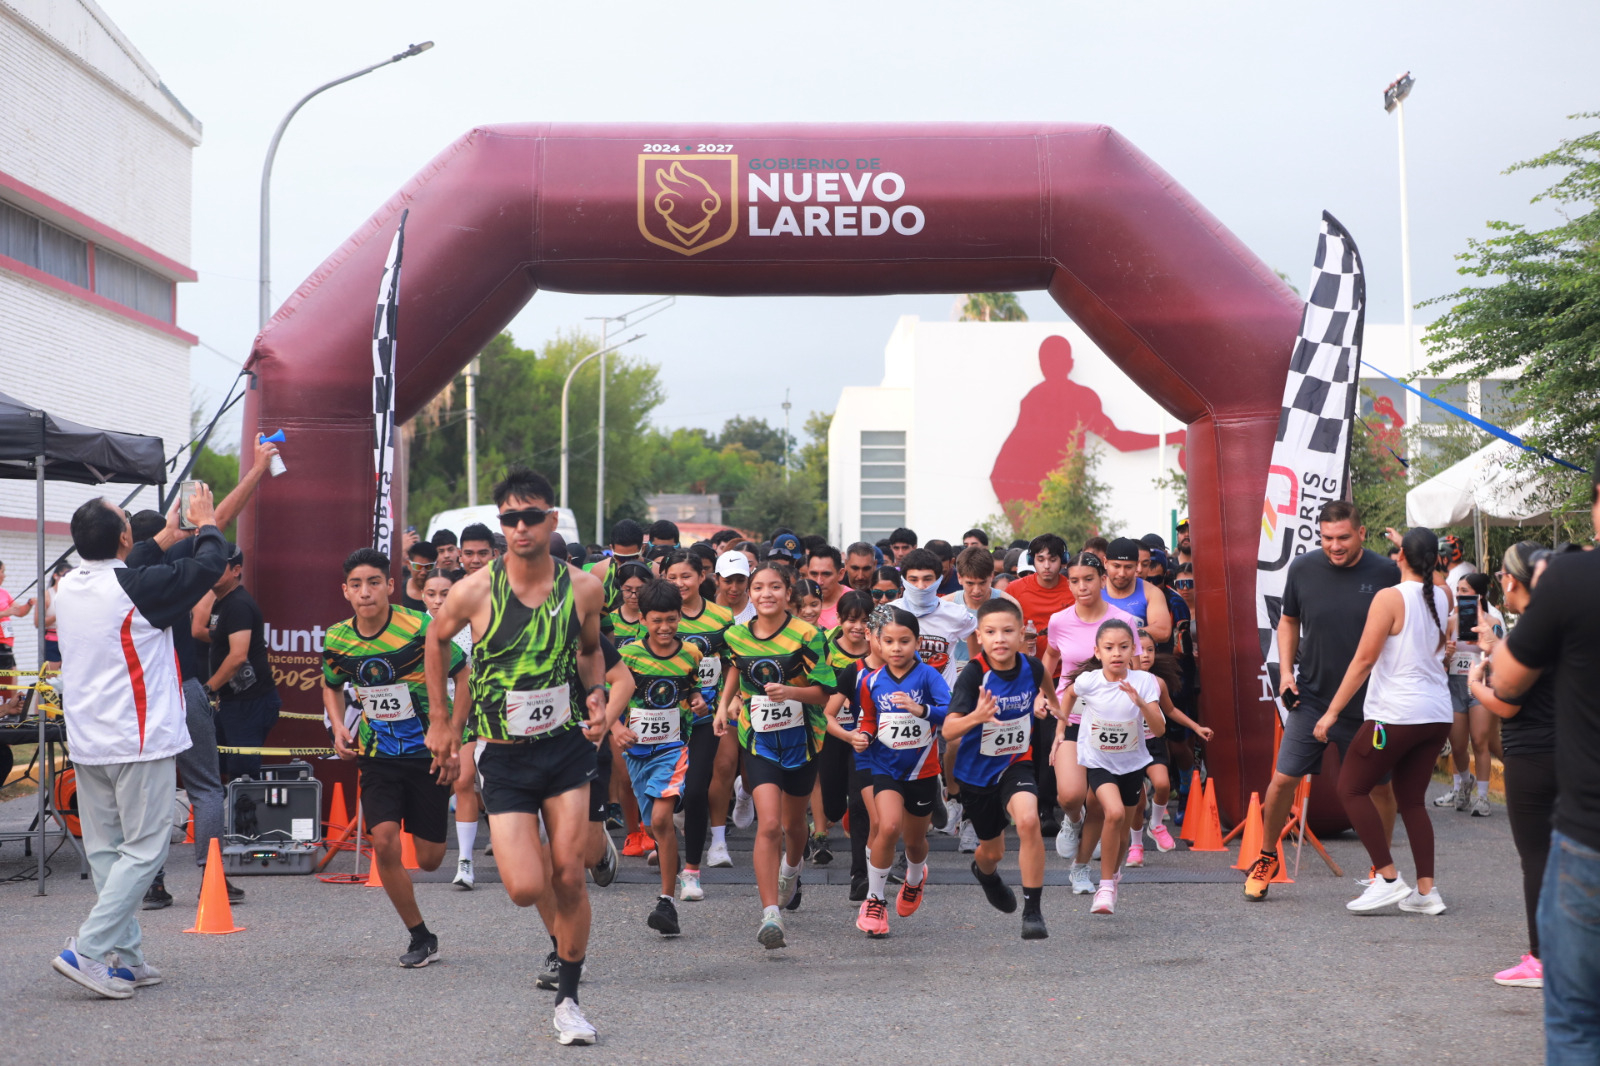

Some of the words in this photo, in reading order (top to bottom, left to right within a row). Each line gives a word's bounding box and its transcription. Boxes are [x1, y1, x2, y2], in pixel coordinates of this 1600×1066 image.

[643, 144, 680, 152] 2024
[697, 144, 733, 152] 2027
[749, 158, 850, 170] GOBIERNO
[855, 158, 881, 170] DE
[748, 172, 906, 203] NUEVO
[748, 205, 926, 236] LAREDO
[1295, 471, 1320, 556] PORTS
[264, 622, 325, 652] Junt
[267, 653, 320, 665] hacemos
[698, 668, 714, 678] 44
[369, 698, 401, 711] 743
[529, 705, 553, 721] 49
[760, 707, 792, 721] 754
[640, 722, 671, 734] 755
[890, 725, 922, 739] 748
[995, 730, 1025, 746] 618
[1099, 732, 1128, 743] 657
